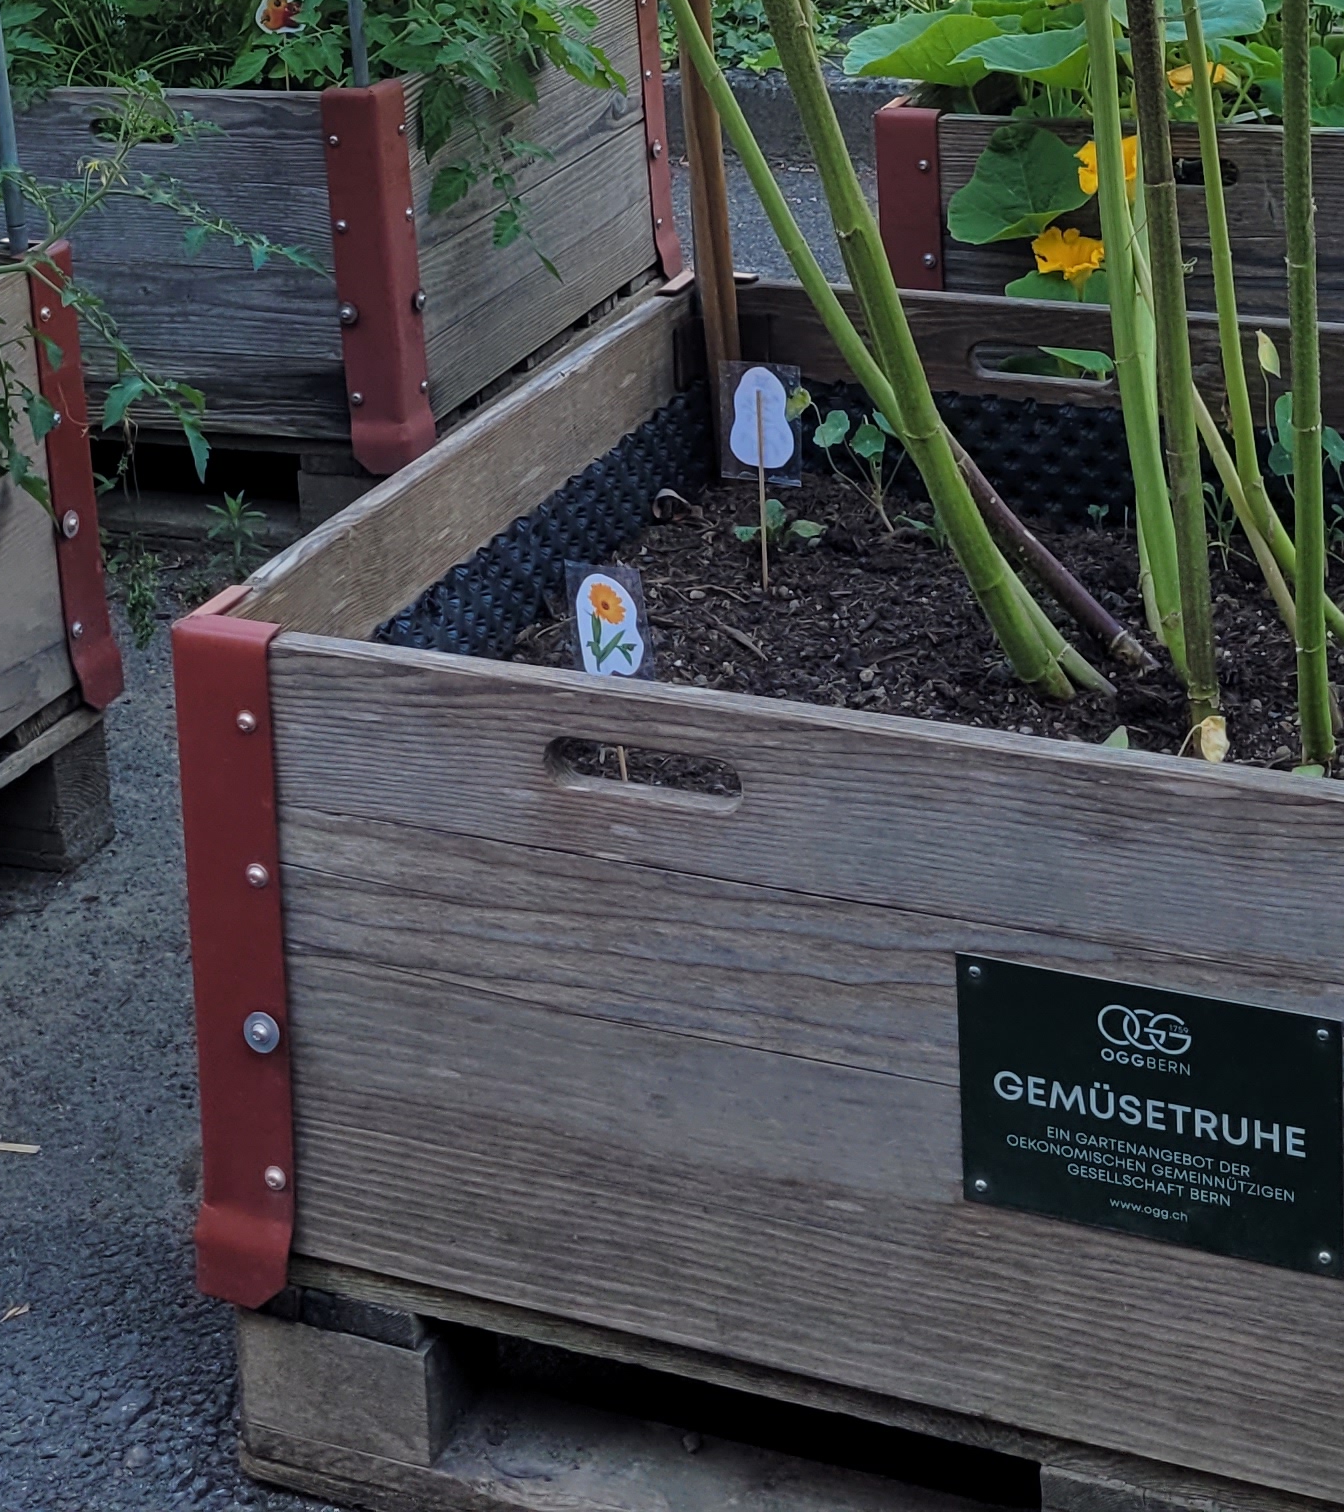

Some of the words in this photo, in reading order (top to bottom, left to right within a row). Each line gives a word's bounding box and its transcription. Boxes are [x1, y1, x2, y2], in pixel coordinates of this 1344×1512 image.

[1169, 1024, 1189, 1034] 1759
[993, 1070, 1307, 1158] GEMÜSETRUHE
[1006, 1134, 1146, 1173] OEKONOMISCHEN
[1151, 1164, 1295, 1203] GEMEINNÜTZIGEN
[1046, 1126, 1070, 1142] EIN
[1075, 1132, 1215, 1170] GARTENANGEBOT
[1220, 1161, 1250, 1178] DER
[1067, 1163, 1184, 1197] GESELLSCHAFT
[1190, 1188, 1231, 1207] BERN
[1109, 1198, 1188, 1222] www.ogg.ch
